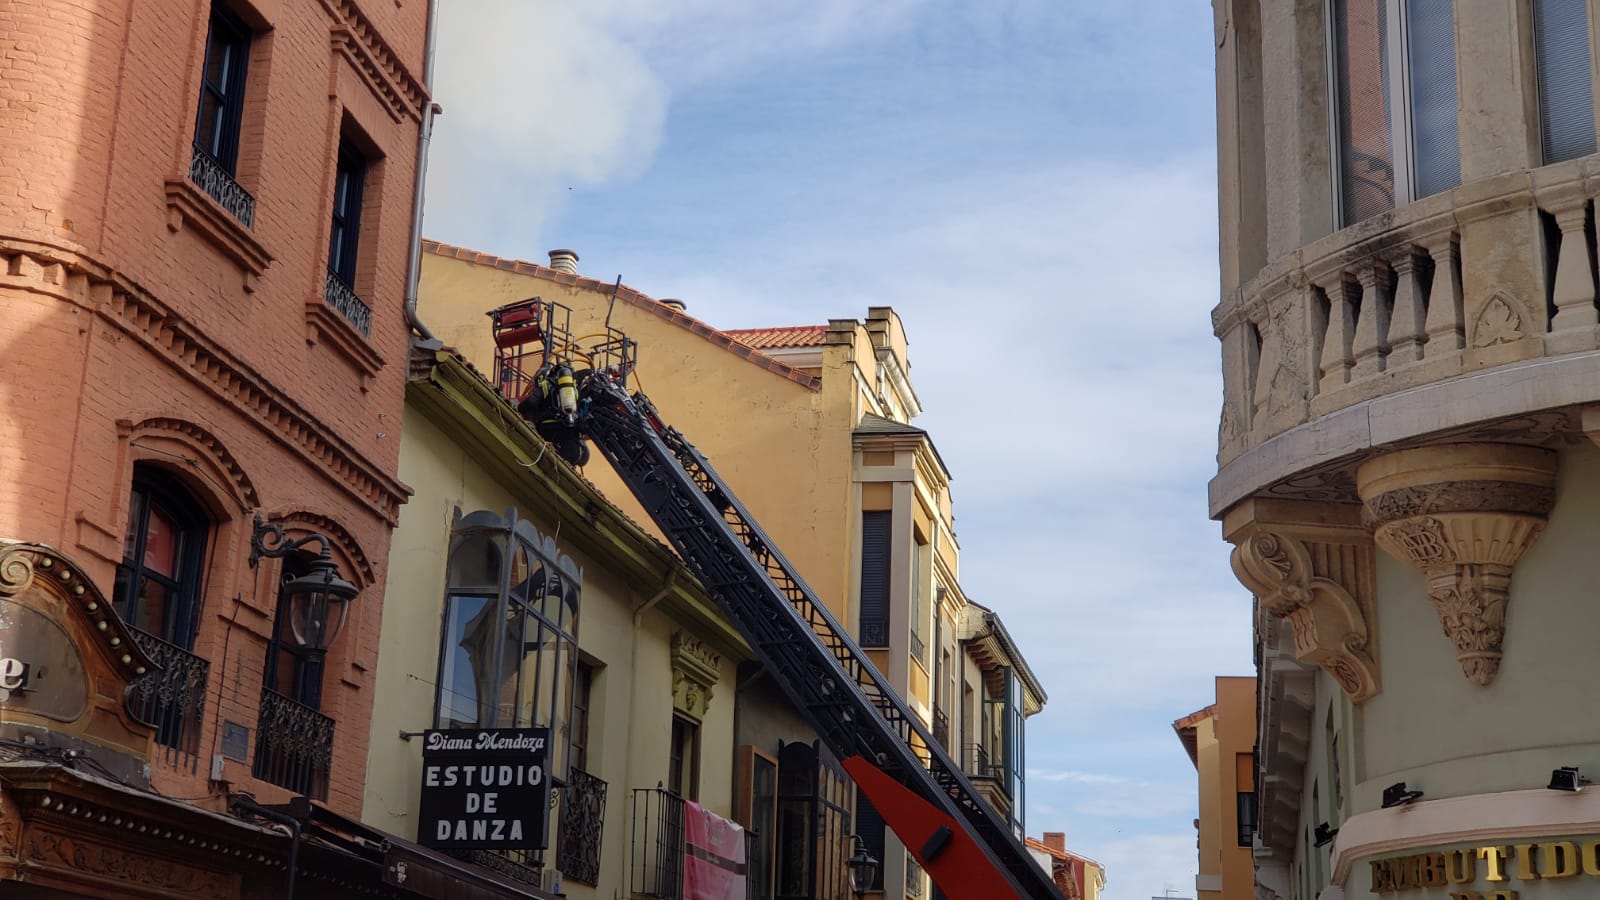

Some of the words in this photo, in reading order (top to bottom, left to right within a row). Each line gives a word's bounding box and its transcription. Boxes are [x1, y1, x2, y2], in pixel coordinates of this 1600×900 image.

[426, 732, 473, 750] Diana
[475, 732, 545, 753] Mendoza
[426, 765, 543, 787] ESTUDIO
[466, 792, 499, 814] DE
[437, 819, 523, 841] DANZA
